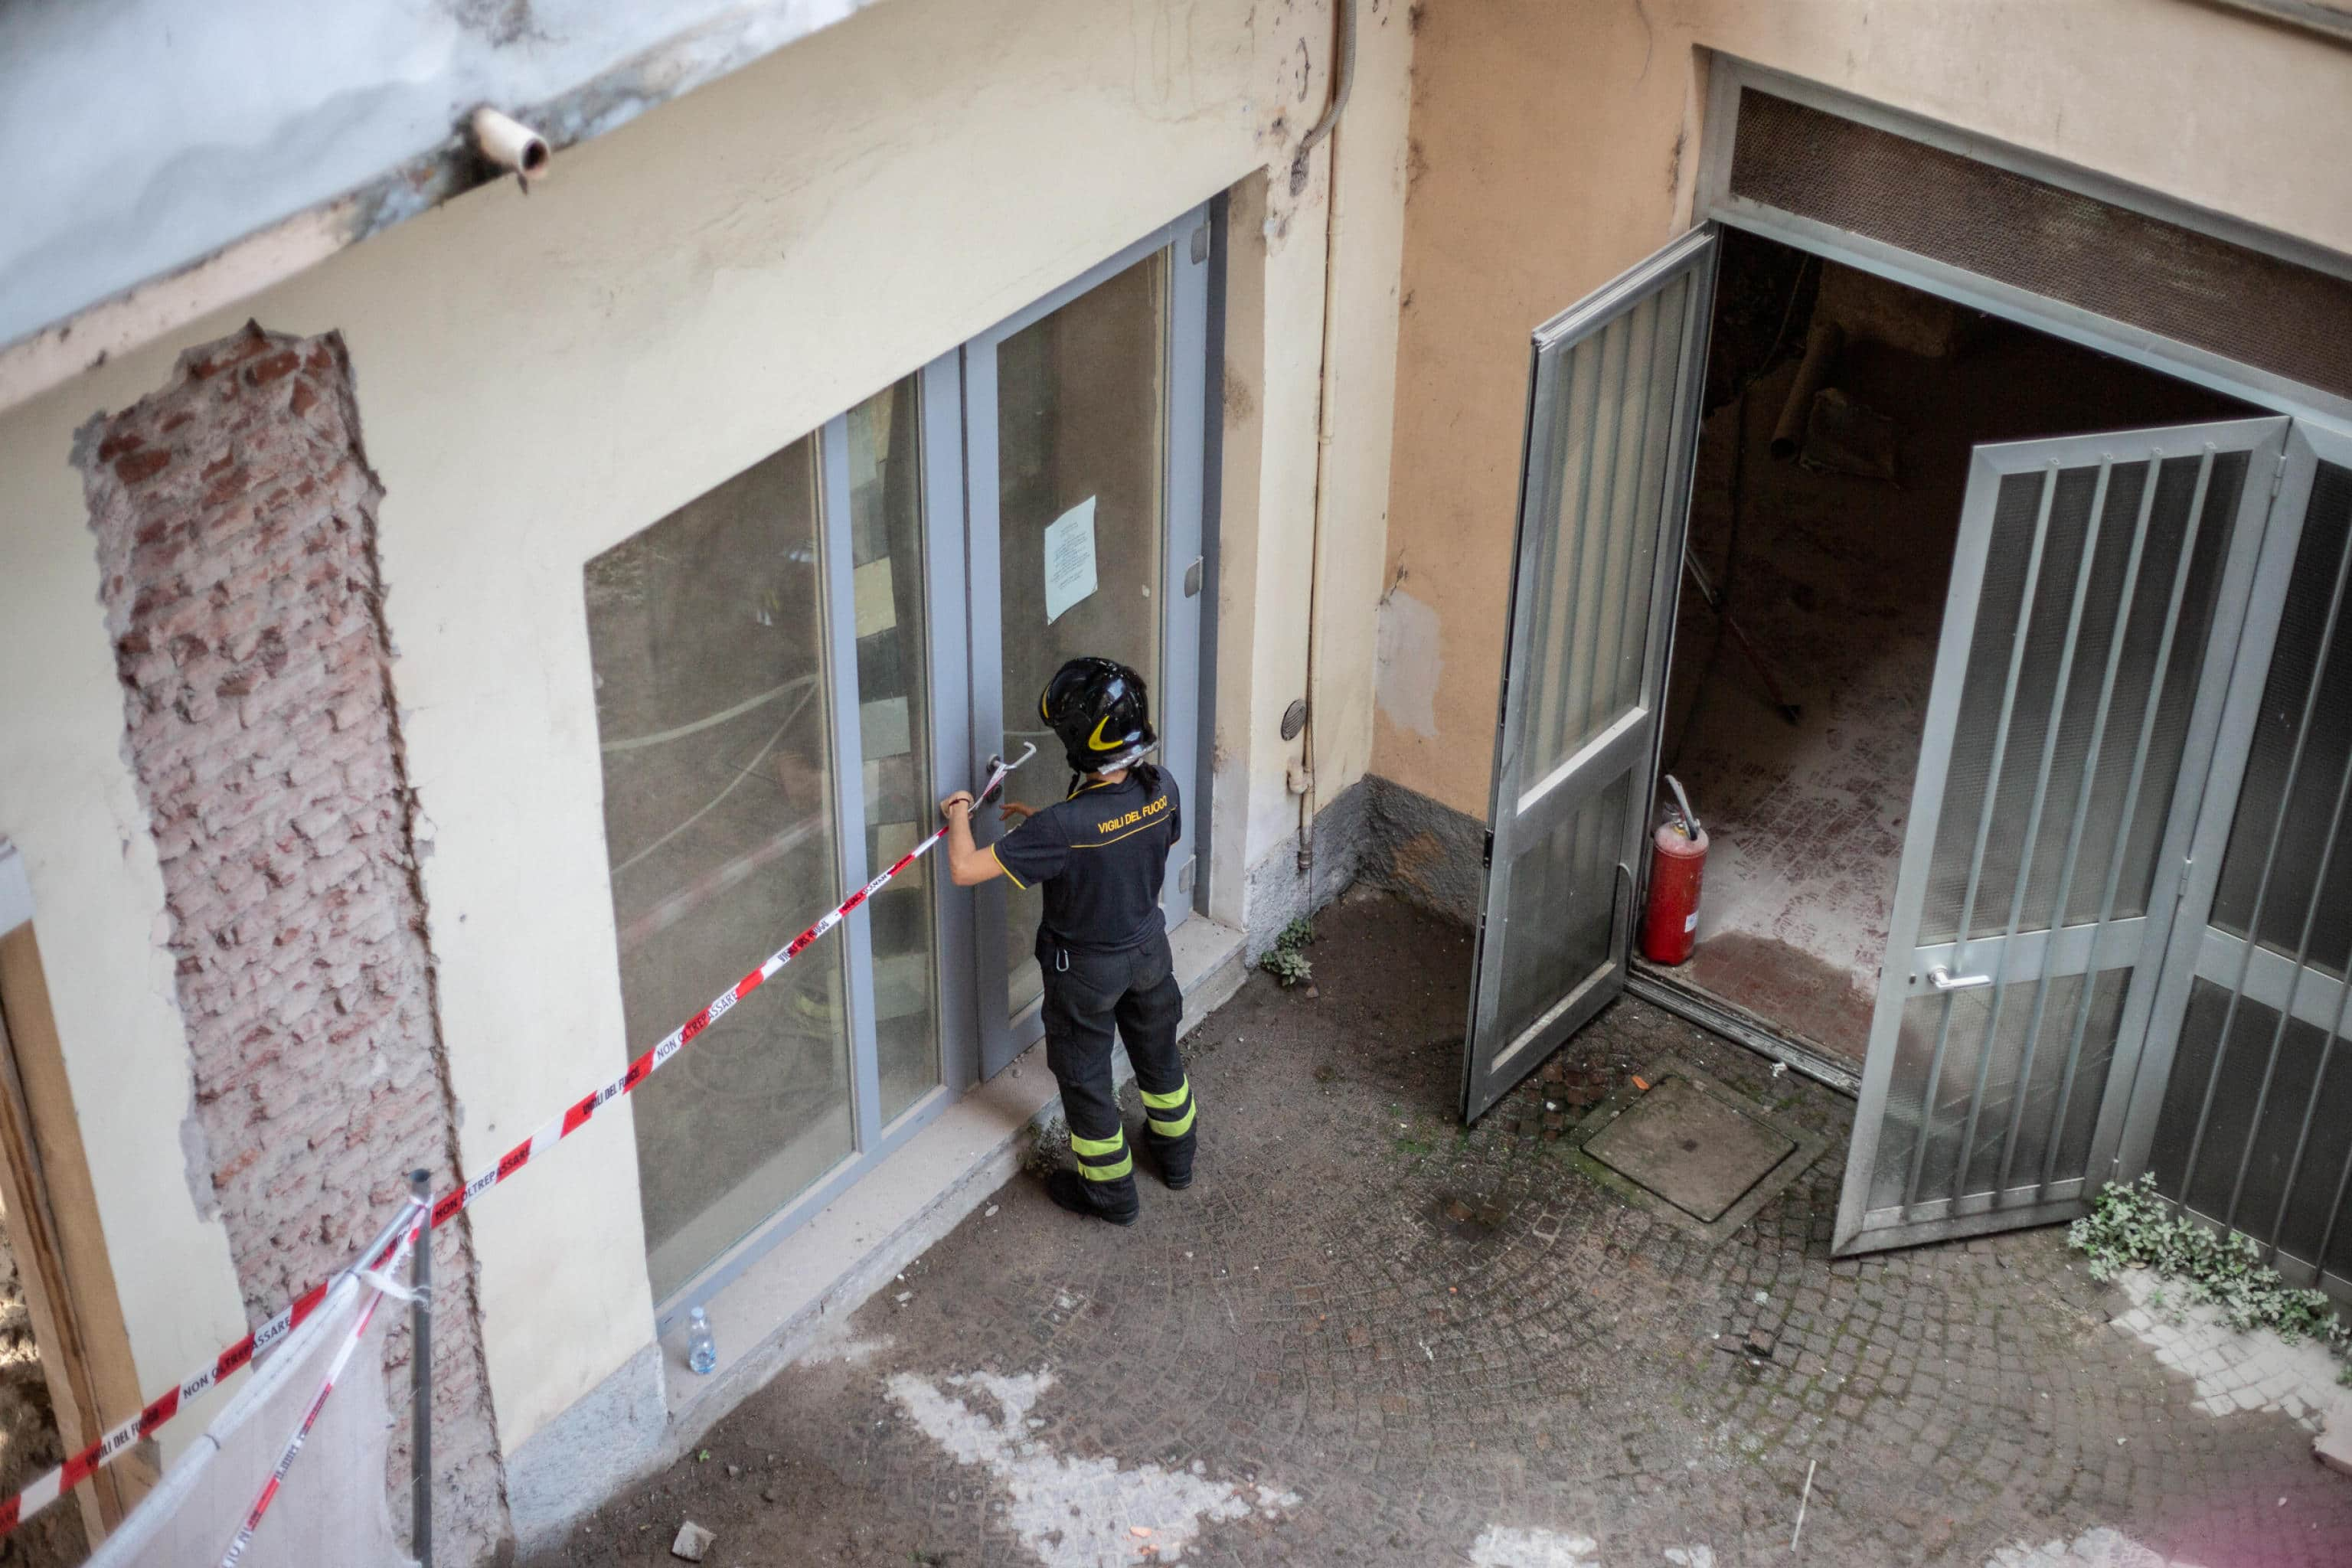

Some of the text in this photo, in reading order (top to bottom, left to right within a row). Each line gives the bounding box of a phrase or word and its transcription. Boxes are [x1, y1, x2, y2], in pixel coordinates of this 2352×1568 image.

[1097, 795, 1168, 834] VIGILI DEL FUOCO
[583, 990, 740, 1116] VIGILI DEL FUOCO NON OLTREPASSARE
[436, 1146, 531, 1220] NON OLTREPASSARE
[113, 1429, 130, 1449] DEL
[183, 1374, 208, 1400] NON
[211, 1316, 291, 1379] OLTREPASSARE
